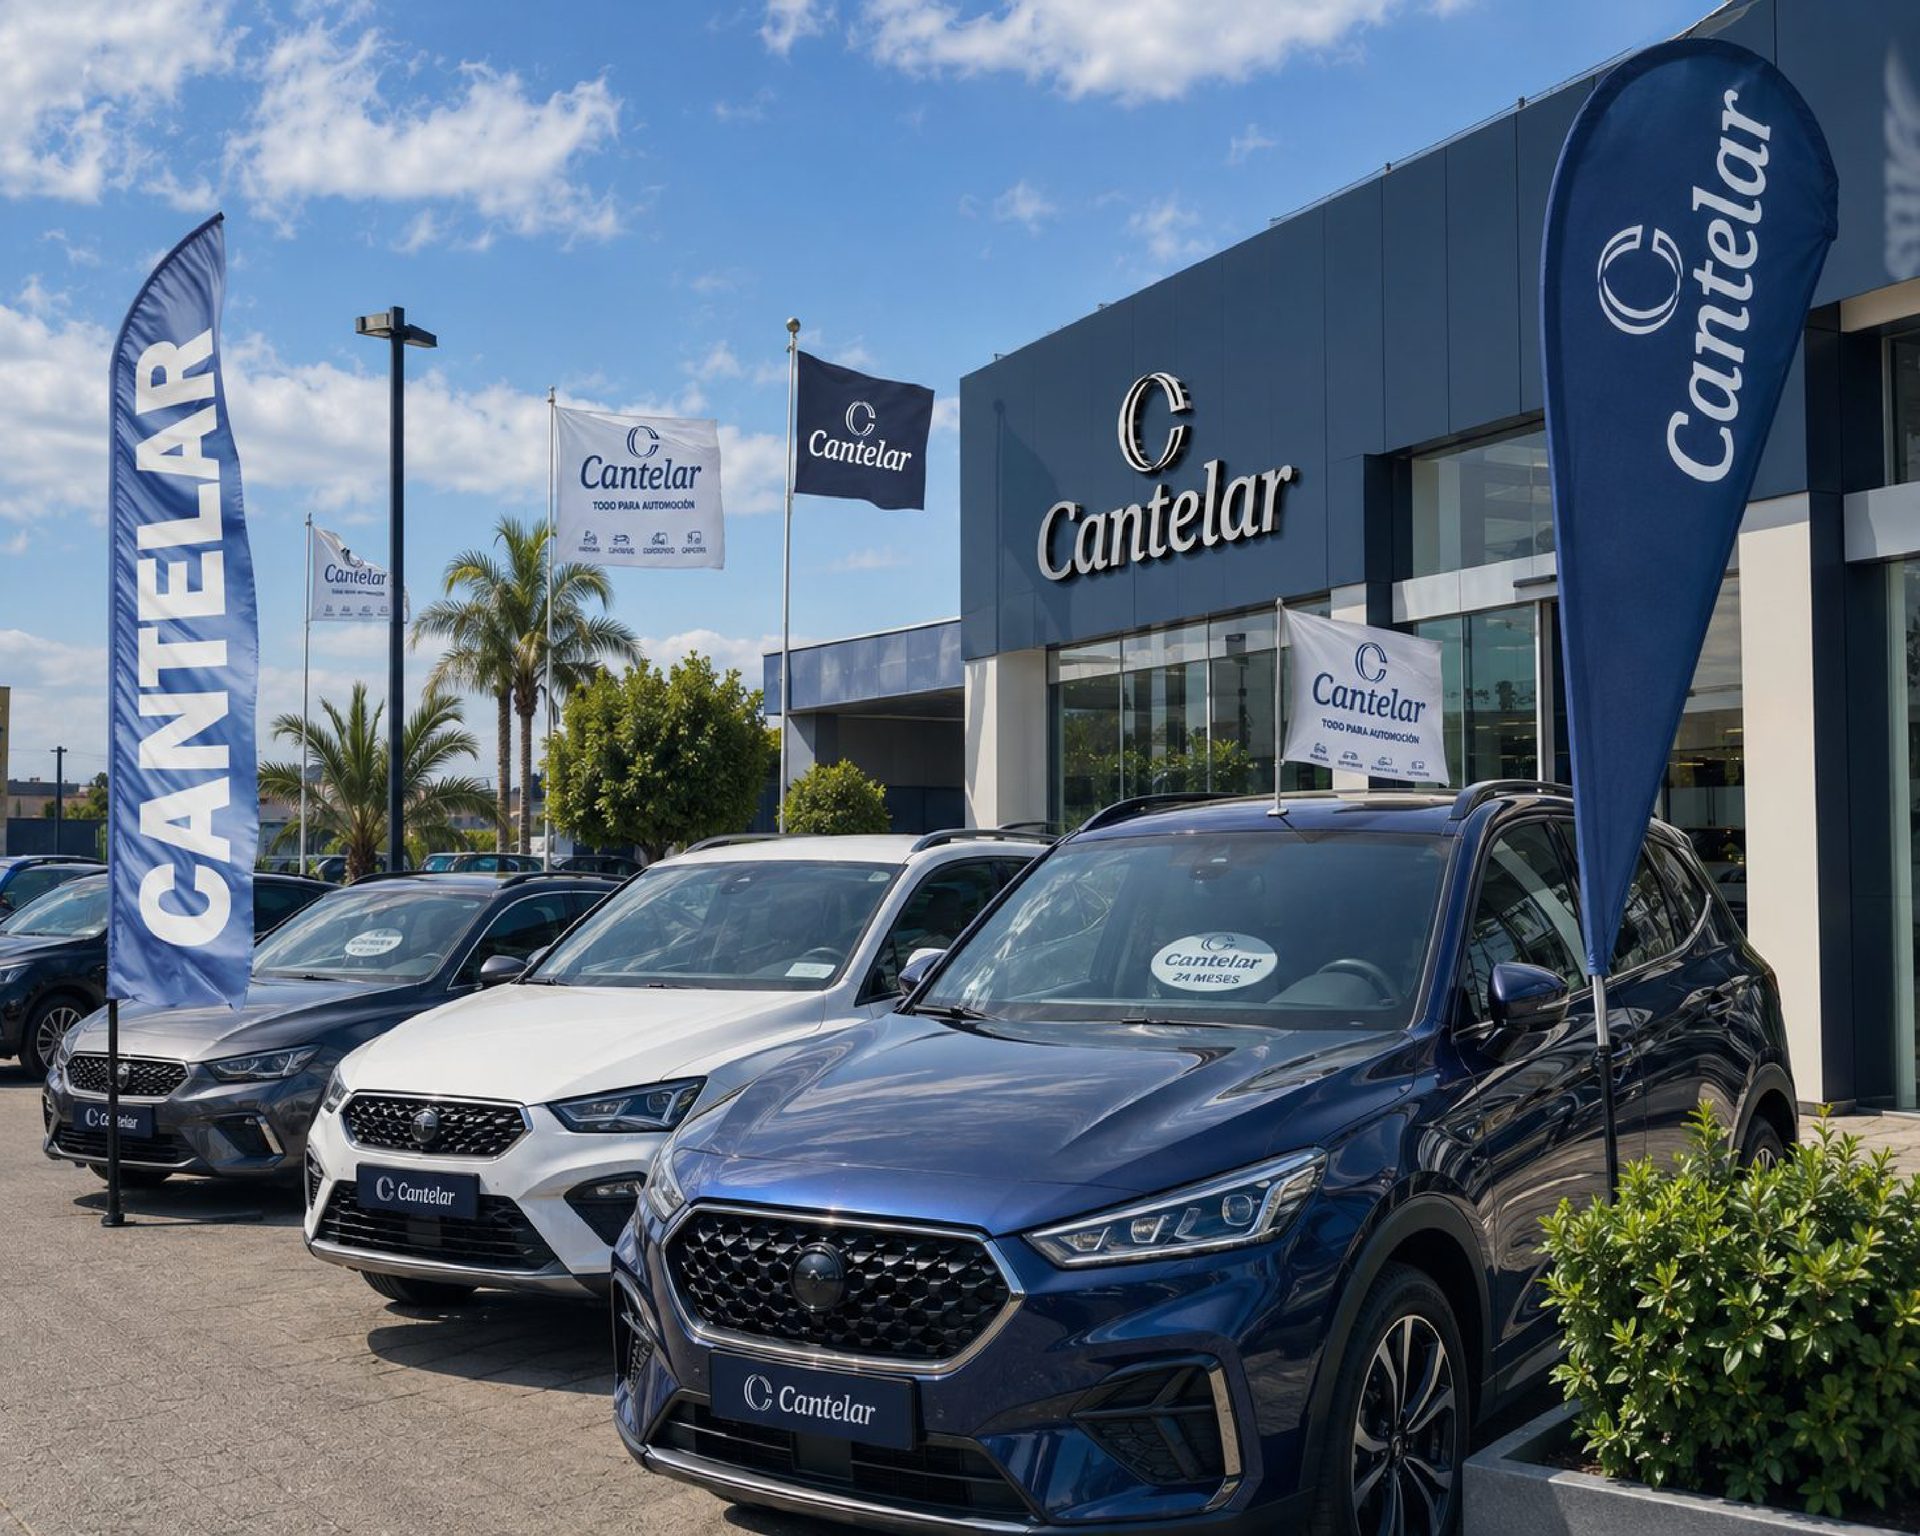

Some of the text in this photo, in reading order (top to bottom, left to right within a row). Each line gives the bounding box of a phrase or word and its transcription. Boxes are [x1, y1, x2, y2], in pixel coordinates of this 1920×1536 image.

[1667, 88, 1772, 483] Cantelar
[809, 430, 912, 471] Cantelar
[580, 455, 702, 490] Cantelar
[618, 501, 640, 510] PARA
[642, 499, 696, 510] AUTOMOCIÓN
[1037, 459, 1297, 581] Cantelar
[324, 563, 387, 585] Cantelar
[135, 327, 232, 948] CANTELAR
[1312, 672, 1426, 723] Cantelar
[1346, 724, 1368, 736] PARA
[1369, 728, 1421, 744] AUTOMOCIÓN
[1165, 953, 1263, 970] Cantelar
[1173, 973, 1241, 984] 24 MESES
[398, 1182, 455, 1206] Cantelar
[779, 1385, 876, 1425] Cantelar
